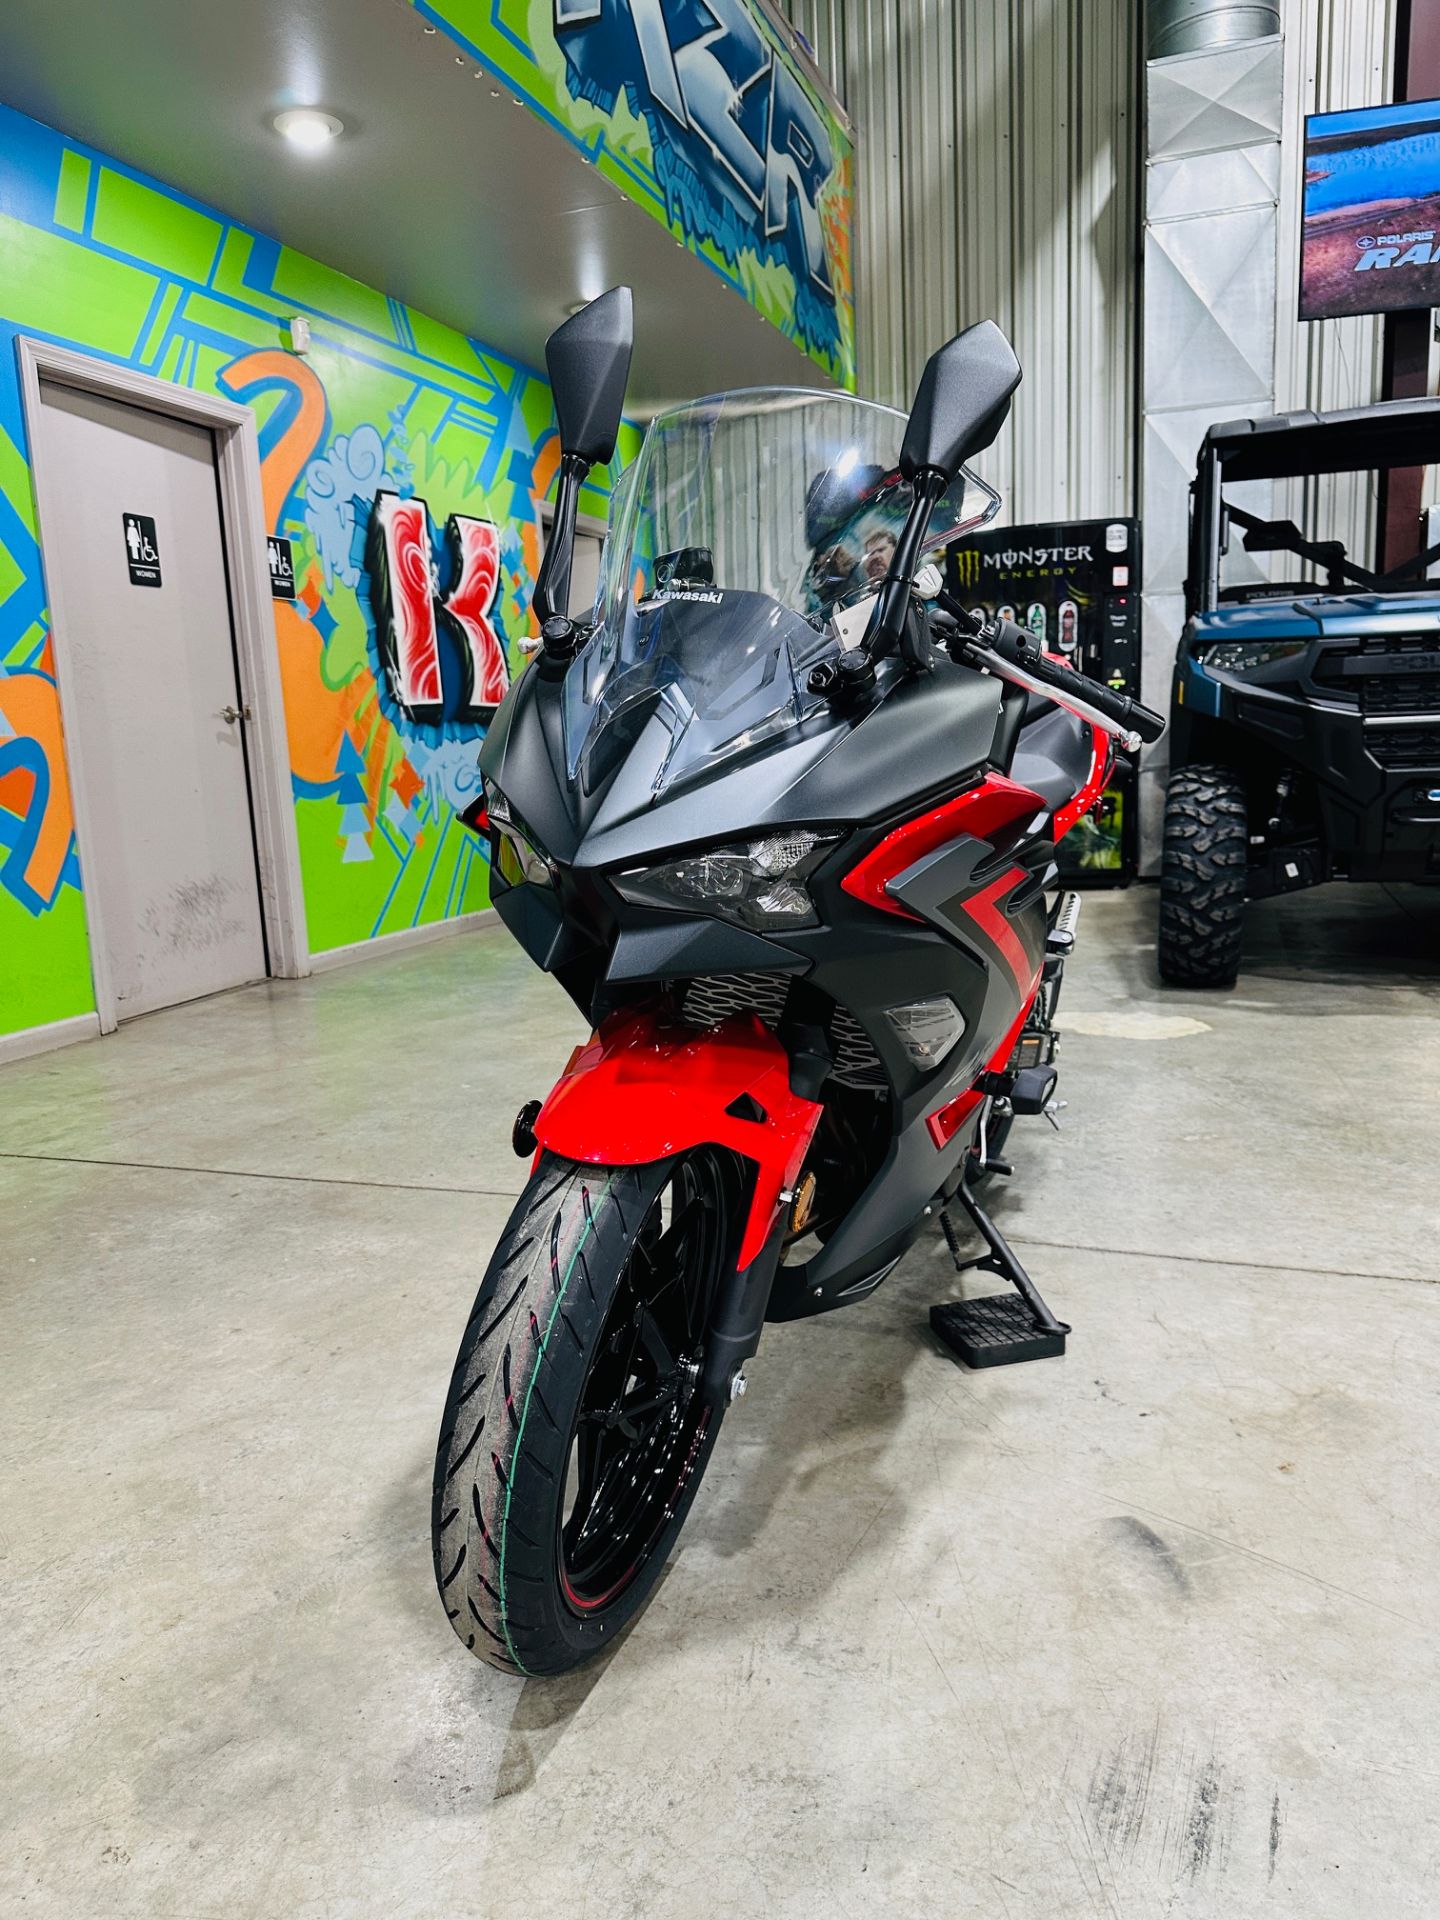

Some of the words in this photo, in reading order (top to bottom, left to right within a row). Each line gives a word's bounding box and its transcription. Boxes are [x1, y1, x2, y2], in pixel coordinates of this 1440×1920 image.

[1376, 230, 1435, 246] POLARIS
[1354, 242, 1440, 272] RA
[983, 545, 1093, 570] MONSTER
[135, 570, 157, 578] WOMEN
[999, 566, 1077, 580] ENERGY
[374, 490, 512, 710] K
[652, 589, 724, 604] Kawasaki
